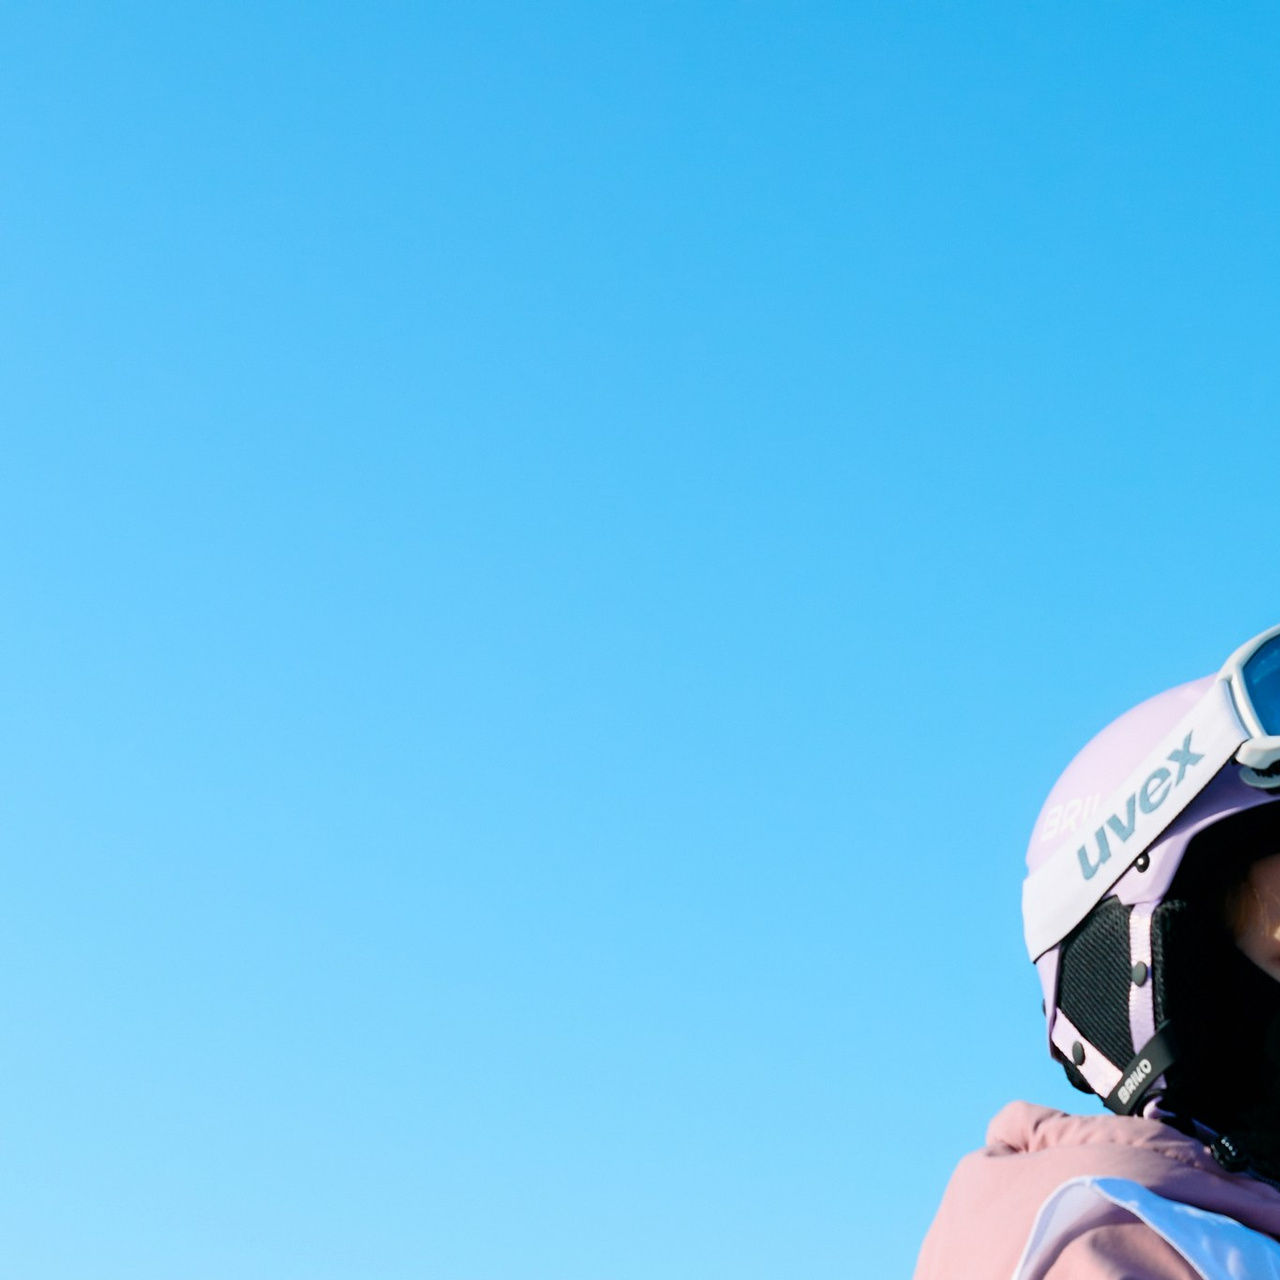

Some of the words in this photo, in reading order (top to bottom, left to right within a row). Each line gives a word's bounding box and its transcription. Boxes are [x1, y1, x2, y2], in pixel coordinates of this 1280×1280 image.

[1039, 793, 1100, 844] BRI
[1077, 728, 1204, 881] uvex
[1118, 1058, 1152, 1105] BRIKO
